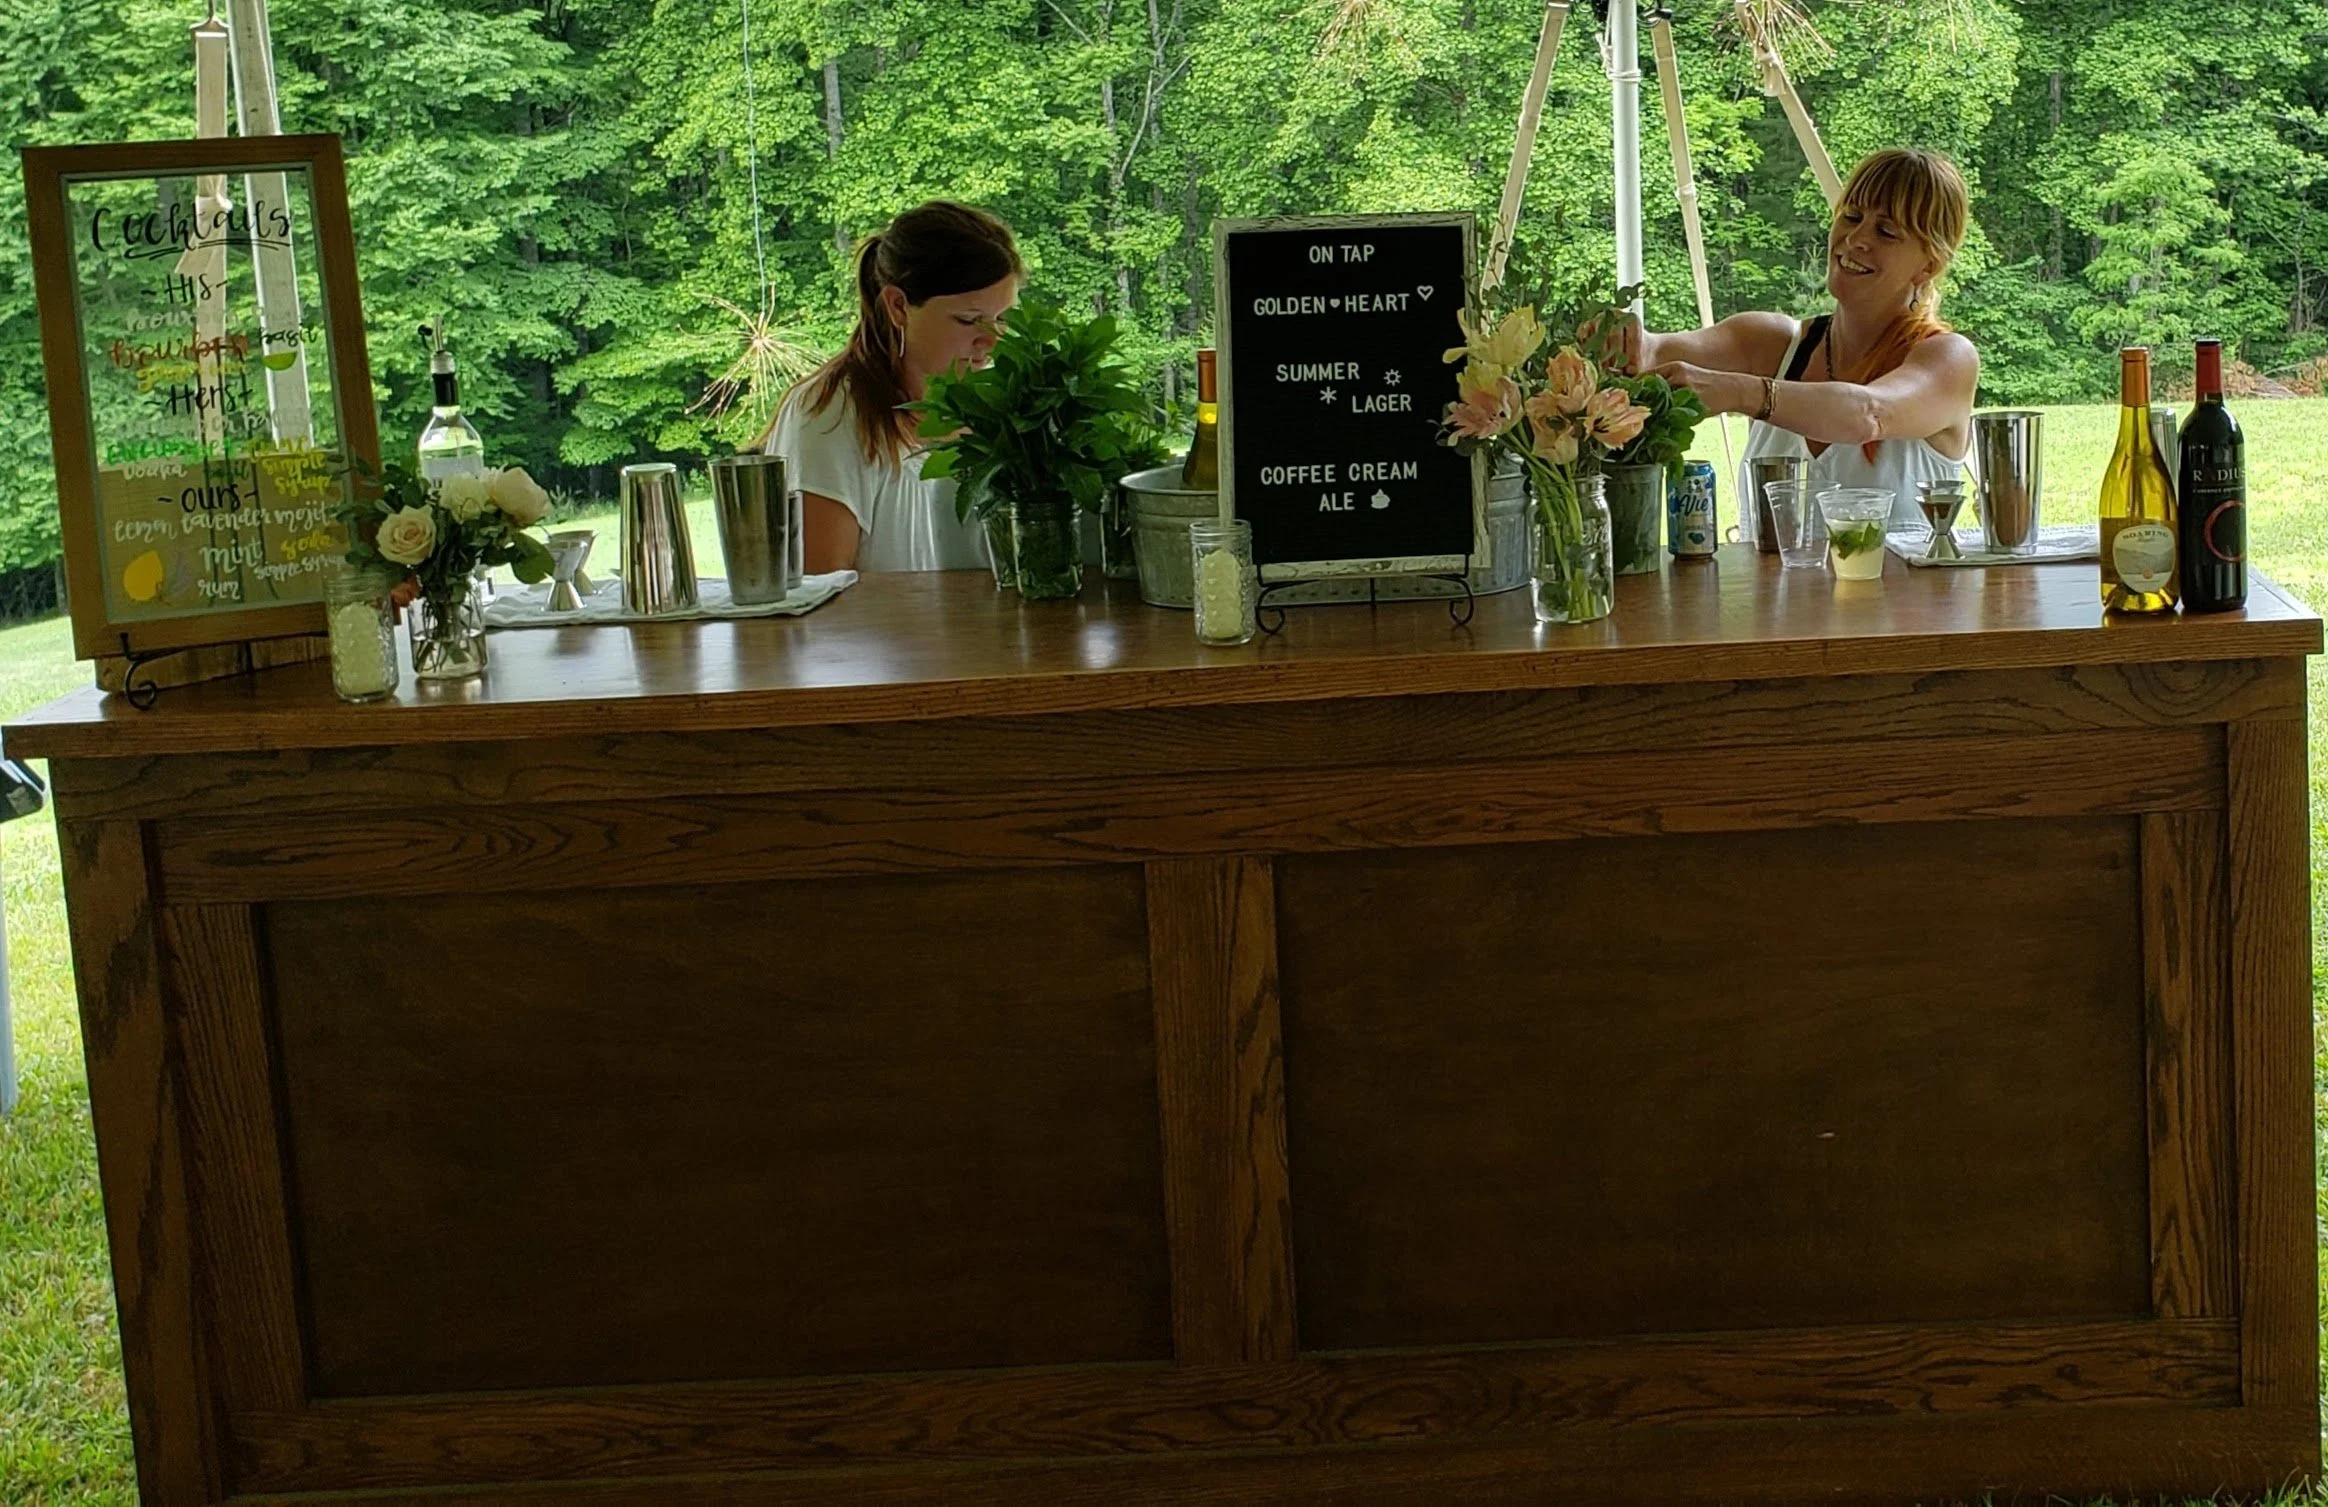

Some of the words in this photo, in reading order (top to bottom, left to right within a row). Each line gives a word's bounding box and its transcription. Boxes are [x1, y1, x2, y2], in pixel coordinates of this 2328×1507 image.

[92, 200, 292, 250] Cocktails
[1309, 245, 1334, 264] ON
[1340, 244, 1376, 263] TAP
[1253, 296, 1326, 316] GOLDEN
[1344, 293, 1410, 313] HEART
[1275, 362, 1361, 382] SUMMER
[1351, 394, 1412, 414] LAGER
[1260, 464, 1337, 485] COFFEE
[1348, 461, 1418, 482] CREAM
[1318, 492, 1356, 512] ALE
[200, 537, 264, 574] mint
[198, 579, 243, 600] rum
